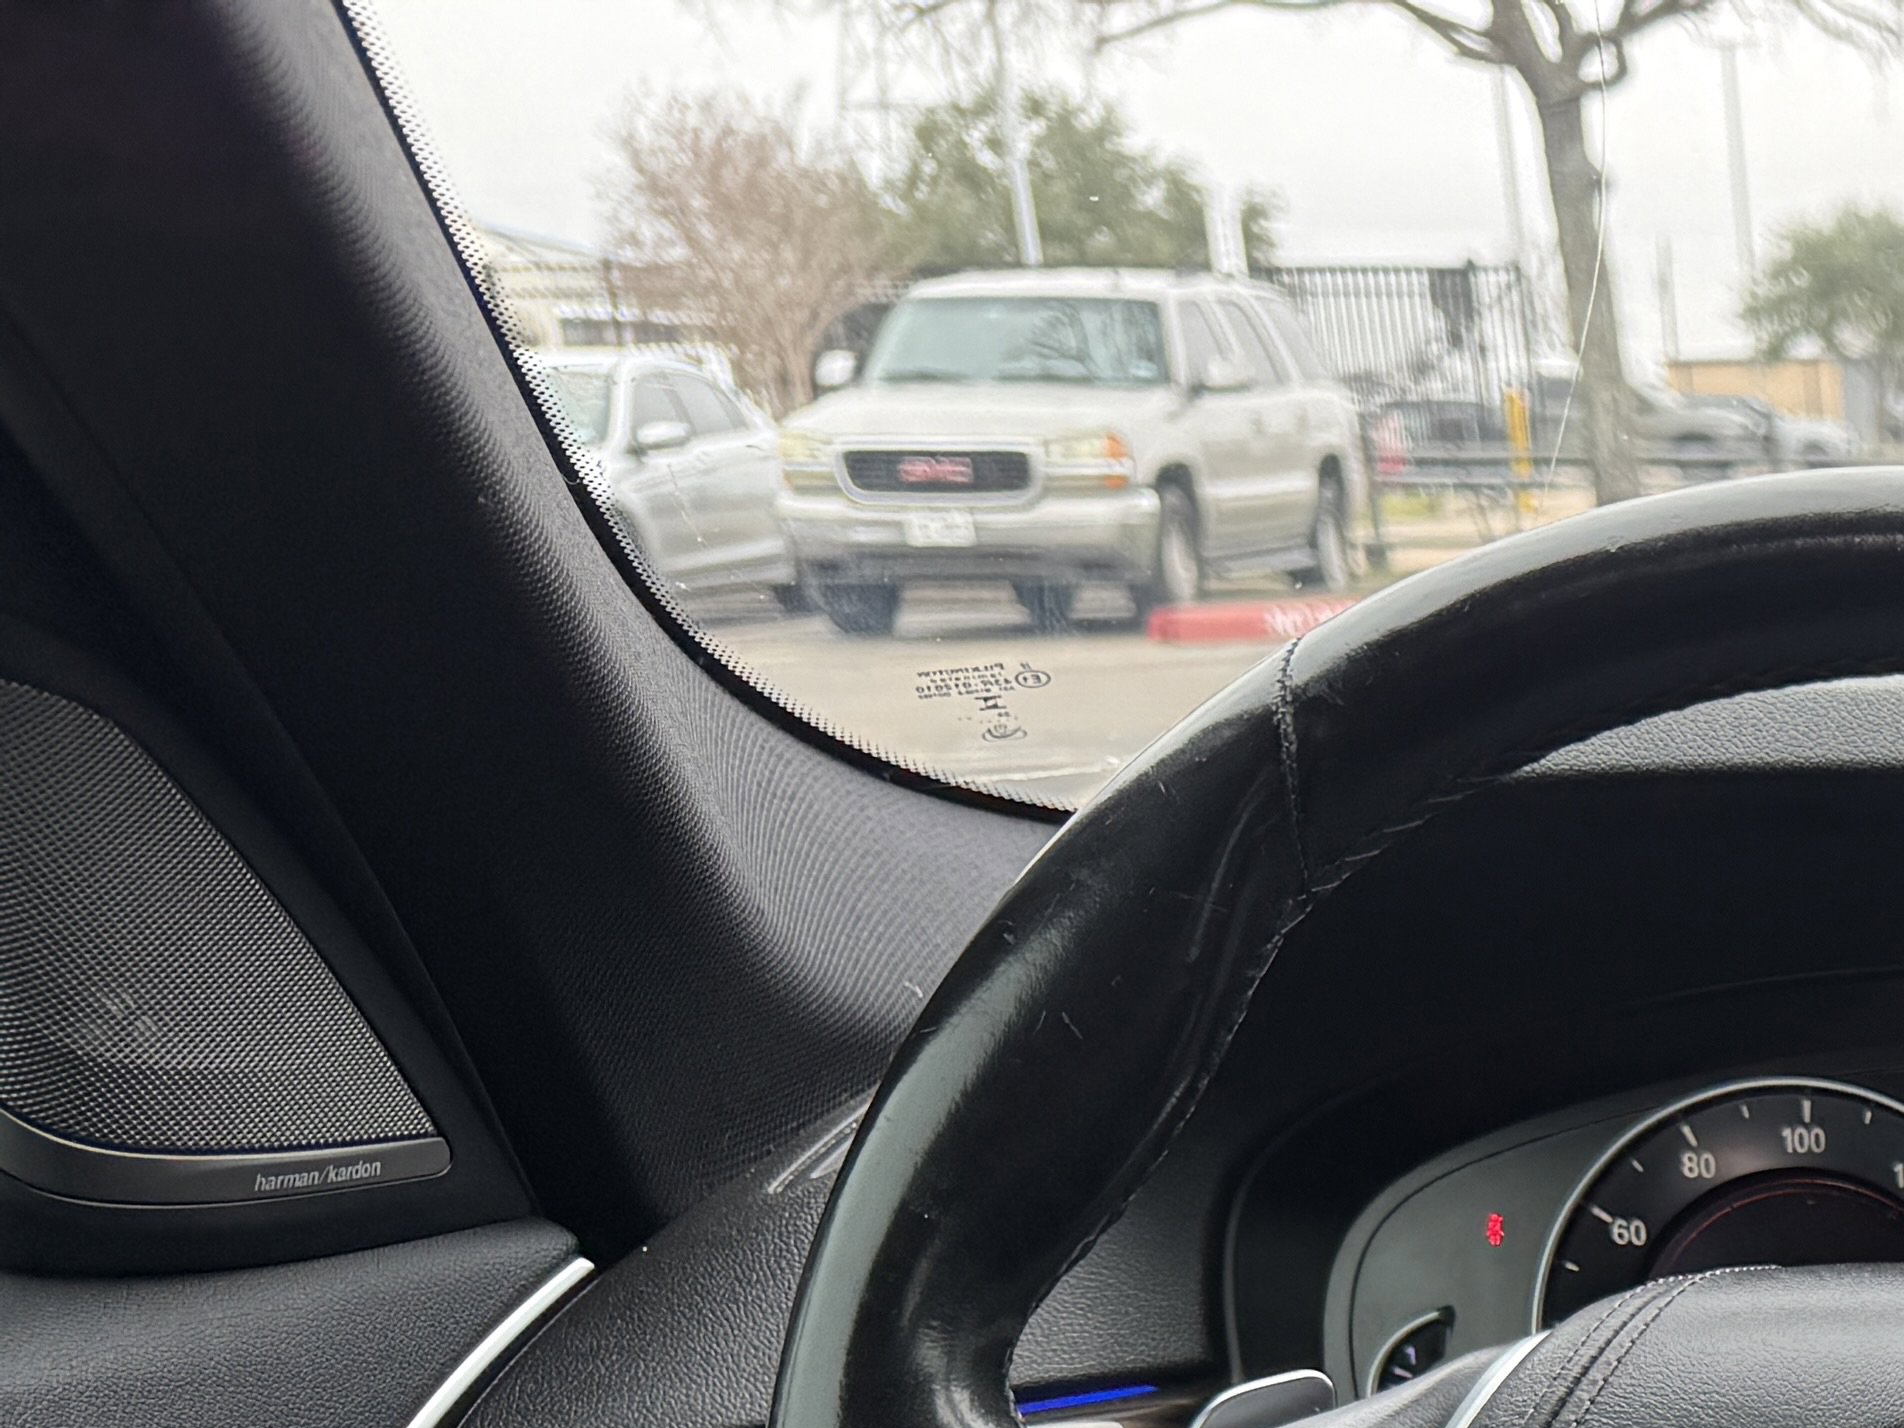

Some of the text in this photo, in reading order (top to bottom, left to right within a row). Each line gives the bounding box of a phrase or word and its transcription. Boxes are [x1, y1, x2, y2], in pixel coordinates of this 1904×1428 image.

[1781, 1127, 1826, 1154] 100
[254, 1160, 382, 1192] harman/kardon
[1680, 1153, 1717, 1178] 80
[1610, 1218, 1648, 1246] 60
